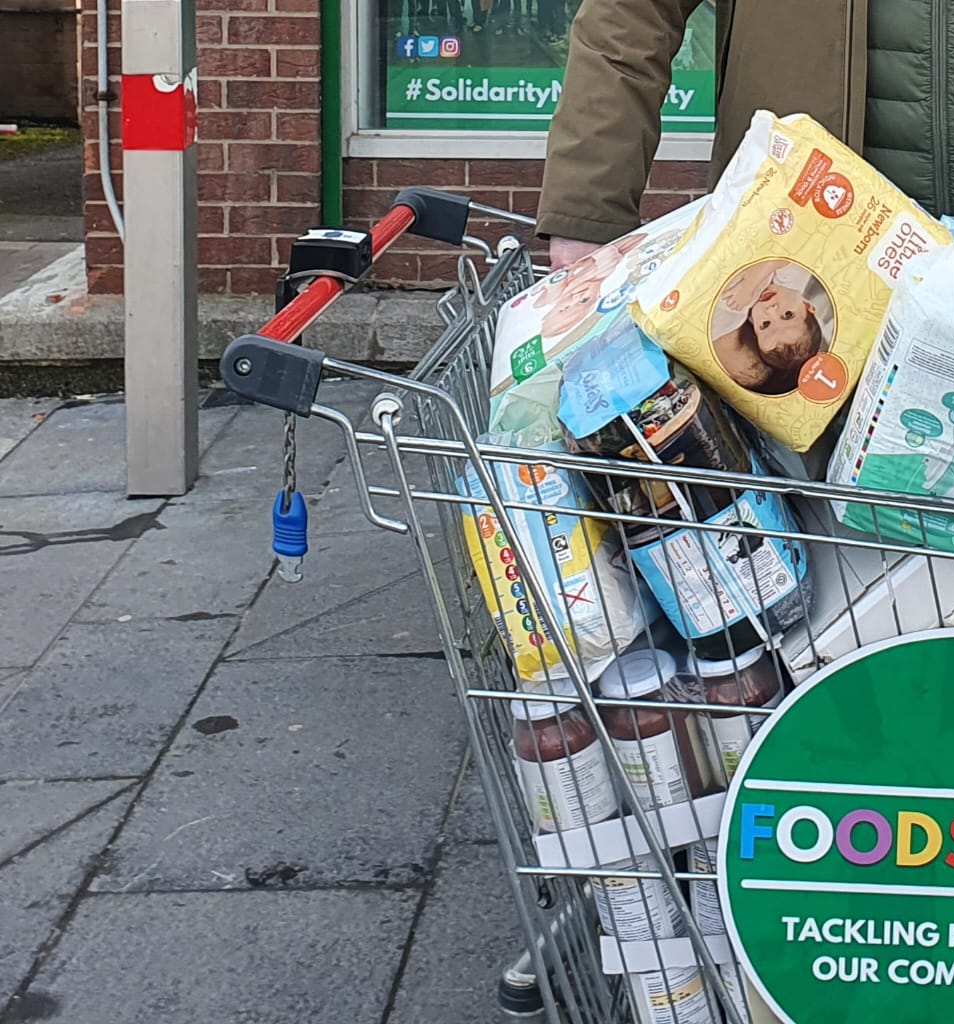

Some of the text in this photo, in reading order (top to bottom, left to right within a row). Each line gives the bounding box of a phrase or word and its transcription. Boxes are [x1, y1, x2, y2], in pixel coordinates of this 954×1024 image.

[867, 195, 881, 214] 26
[854, 203, 893, 256] Newborn
[877, 222, 912, 270] ones
[813, 369, 838, 390] 1
[782, 916, 940, 948] TACKLING
[812, 956, 880, 983] OUR
